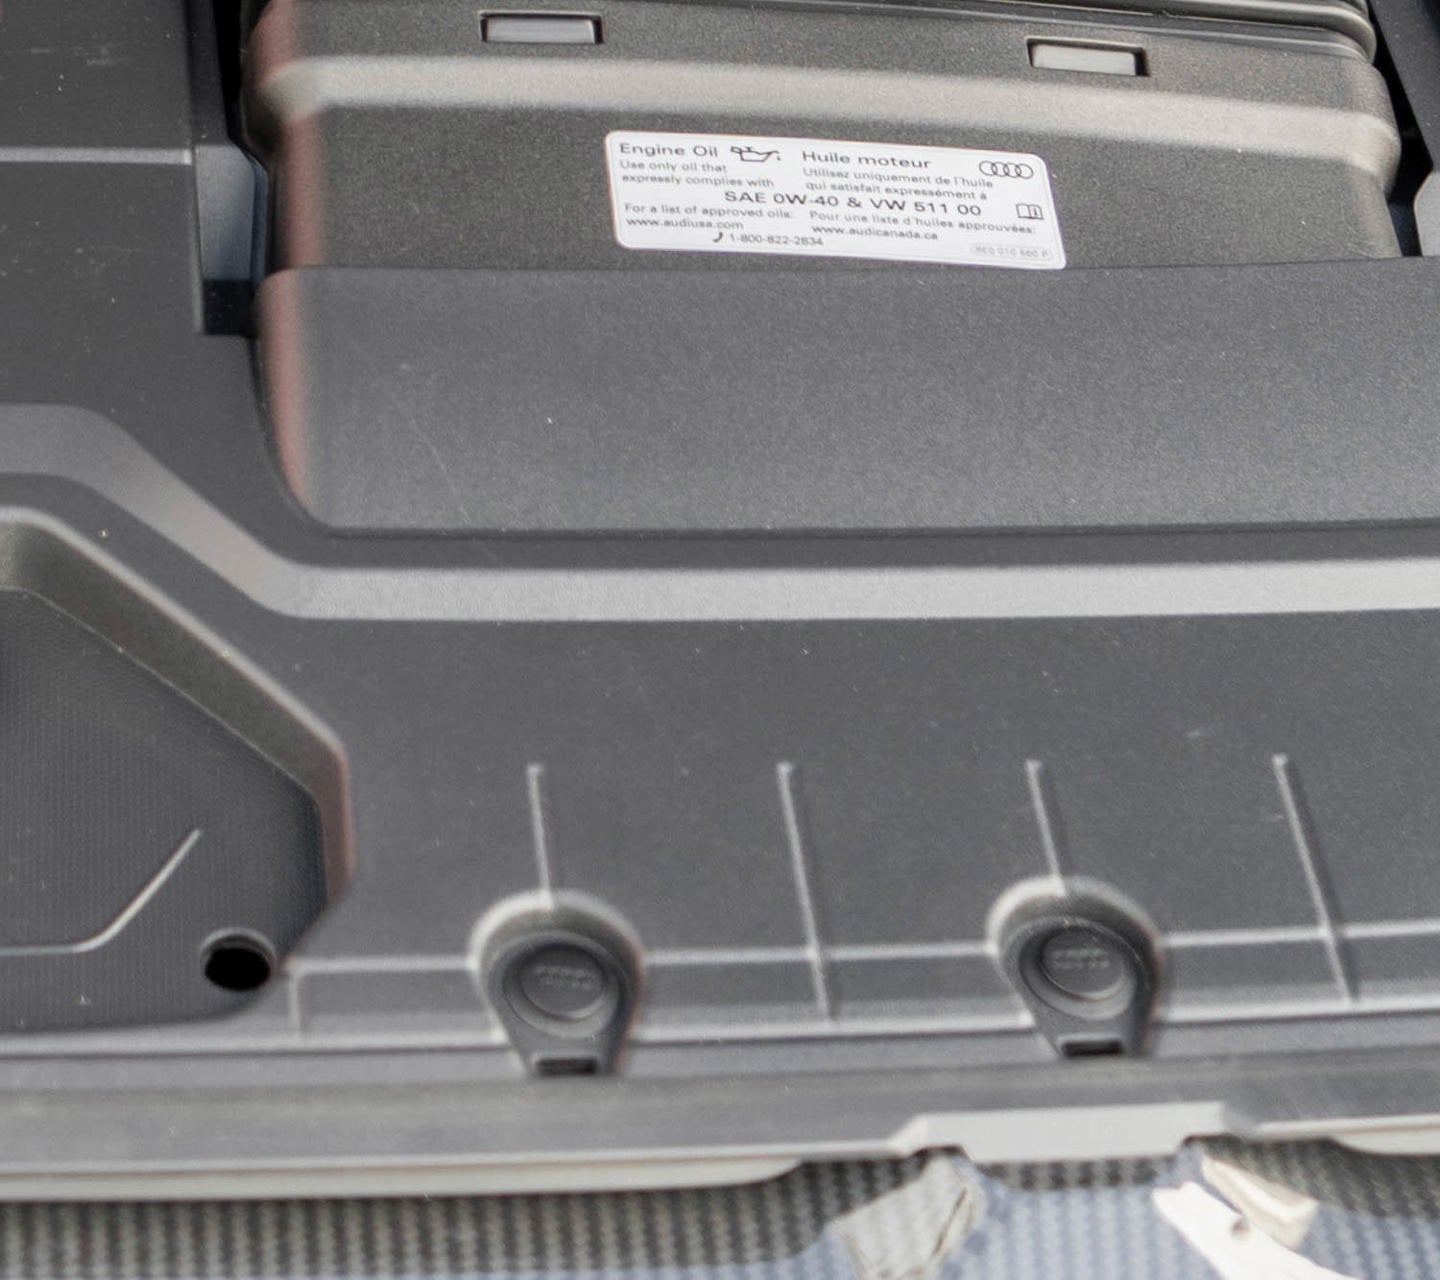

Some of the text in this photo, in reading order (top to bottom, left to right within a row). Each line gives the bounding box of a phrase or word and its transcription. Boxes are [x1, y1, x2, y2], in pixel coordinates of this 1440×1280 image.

[619, 143, 718, 157] Engine Oil
[620, 160, 728, 173] Use only oil that
[802, 150, 933, 169] Huile moteur
[622, 174, 775, 188] expressly complies with
[803, 167, 993, 188] Utilisez uniquement de l'huile
[806, 182, 826, 192] qui
[830, 184, 881, 194] satisfait
[885, 186, 977, 199] expressément
[624, 203, 646, 213] For
[661, 204, 680, 214] list
[684, 204, 697, 214] of
[701, 208, 763, 219] approved
[724, 190, 982, 216] SAE 0W-40 & VW 511 00
[626, 218, 744, 230] www.audiusa.com
[810, 210, 840, 221] Pour
[844, 214, 868, 223] une
[872, 214, 899, 225] liste
[904, 216, 954, 228] d'huiles
[811, 225, 938, 241] www.audicanada.ca
